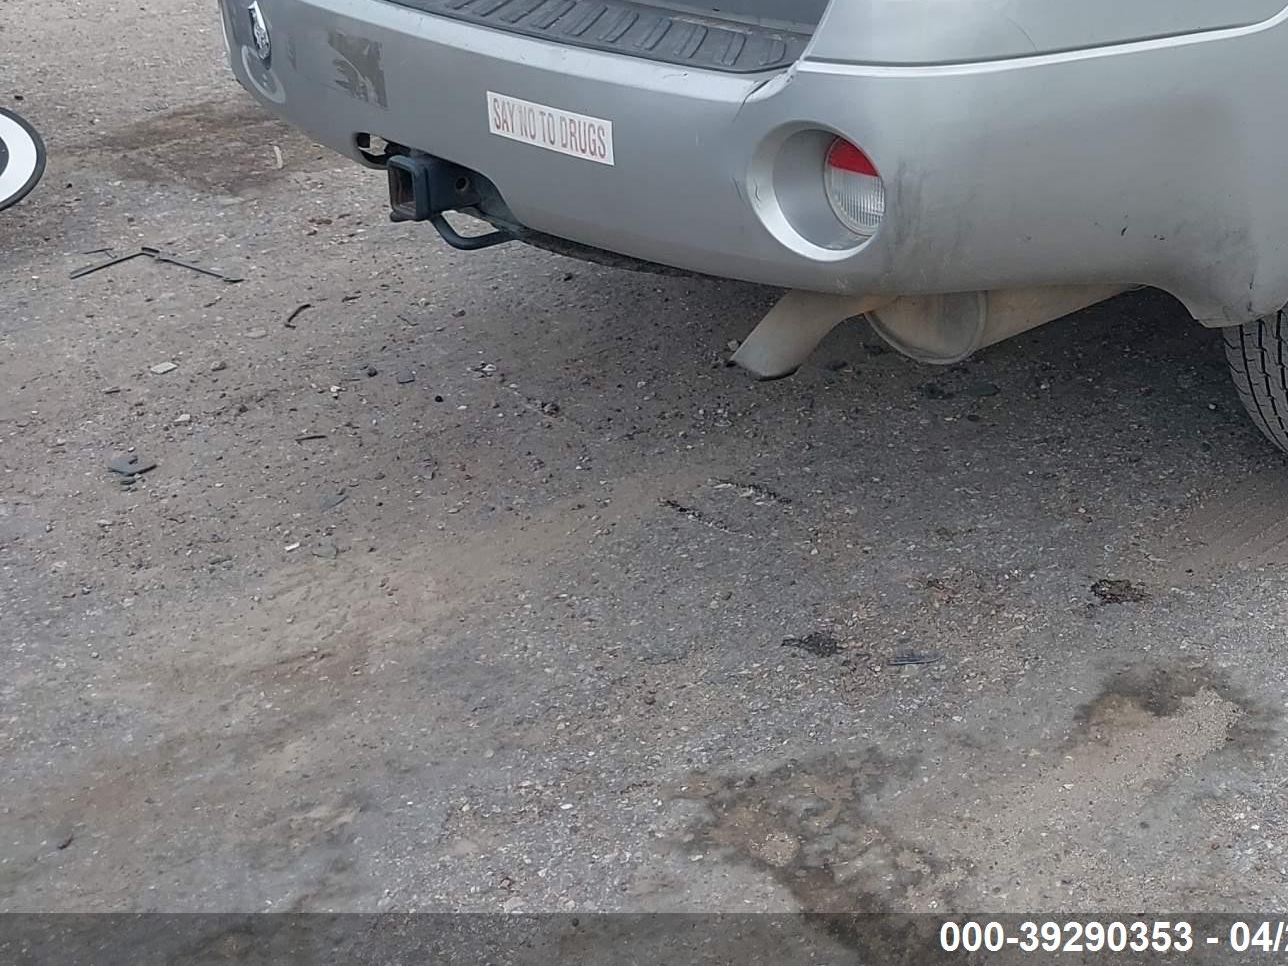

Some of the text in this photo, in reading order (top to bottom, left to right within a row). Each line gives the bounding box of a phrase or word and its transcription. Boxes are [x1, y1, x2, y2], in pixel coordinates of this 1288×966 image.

[492, 97, 607, 159] SAY NO TO DRUGS
